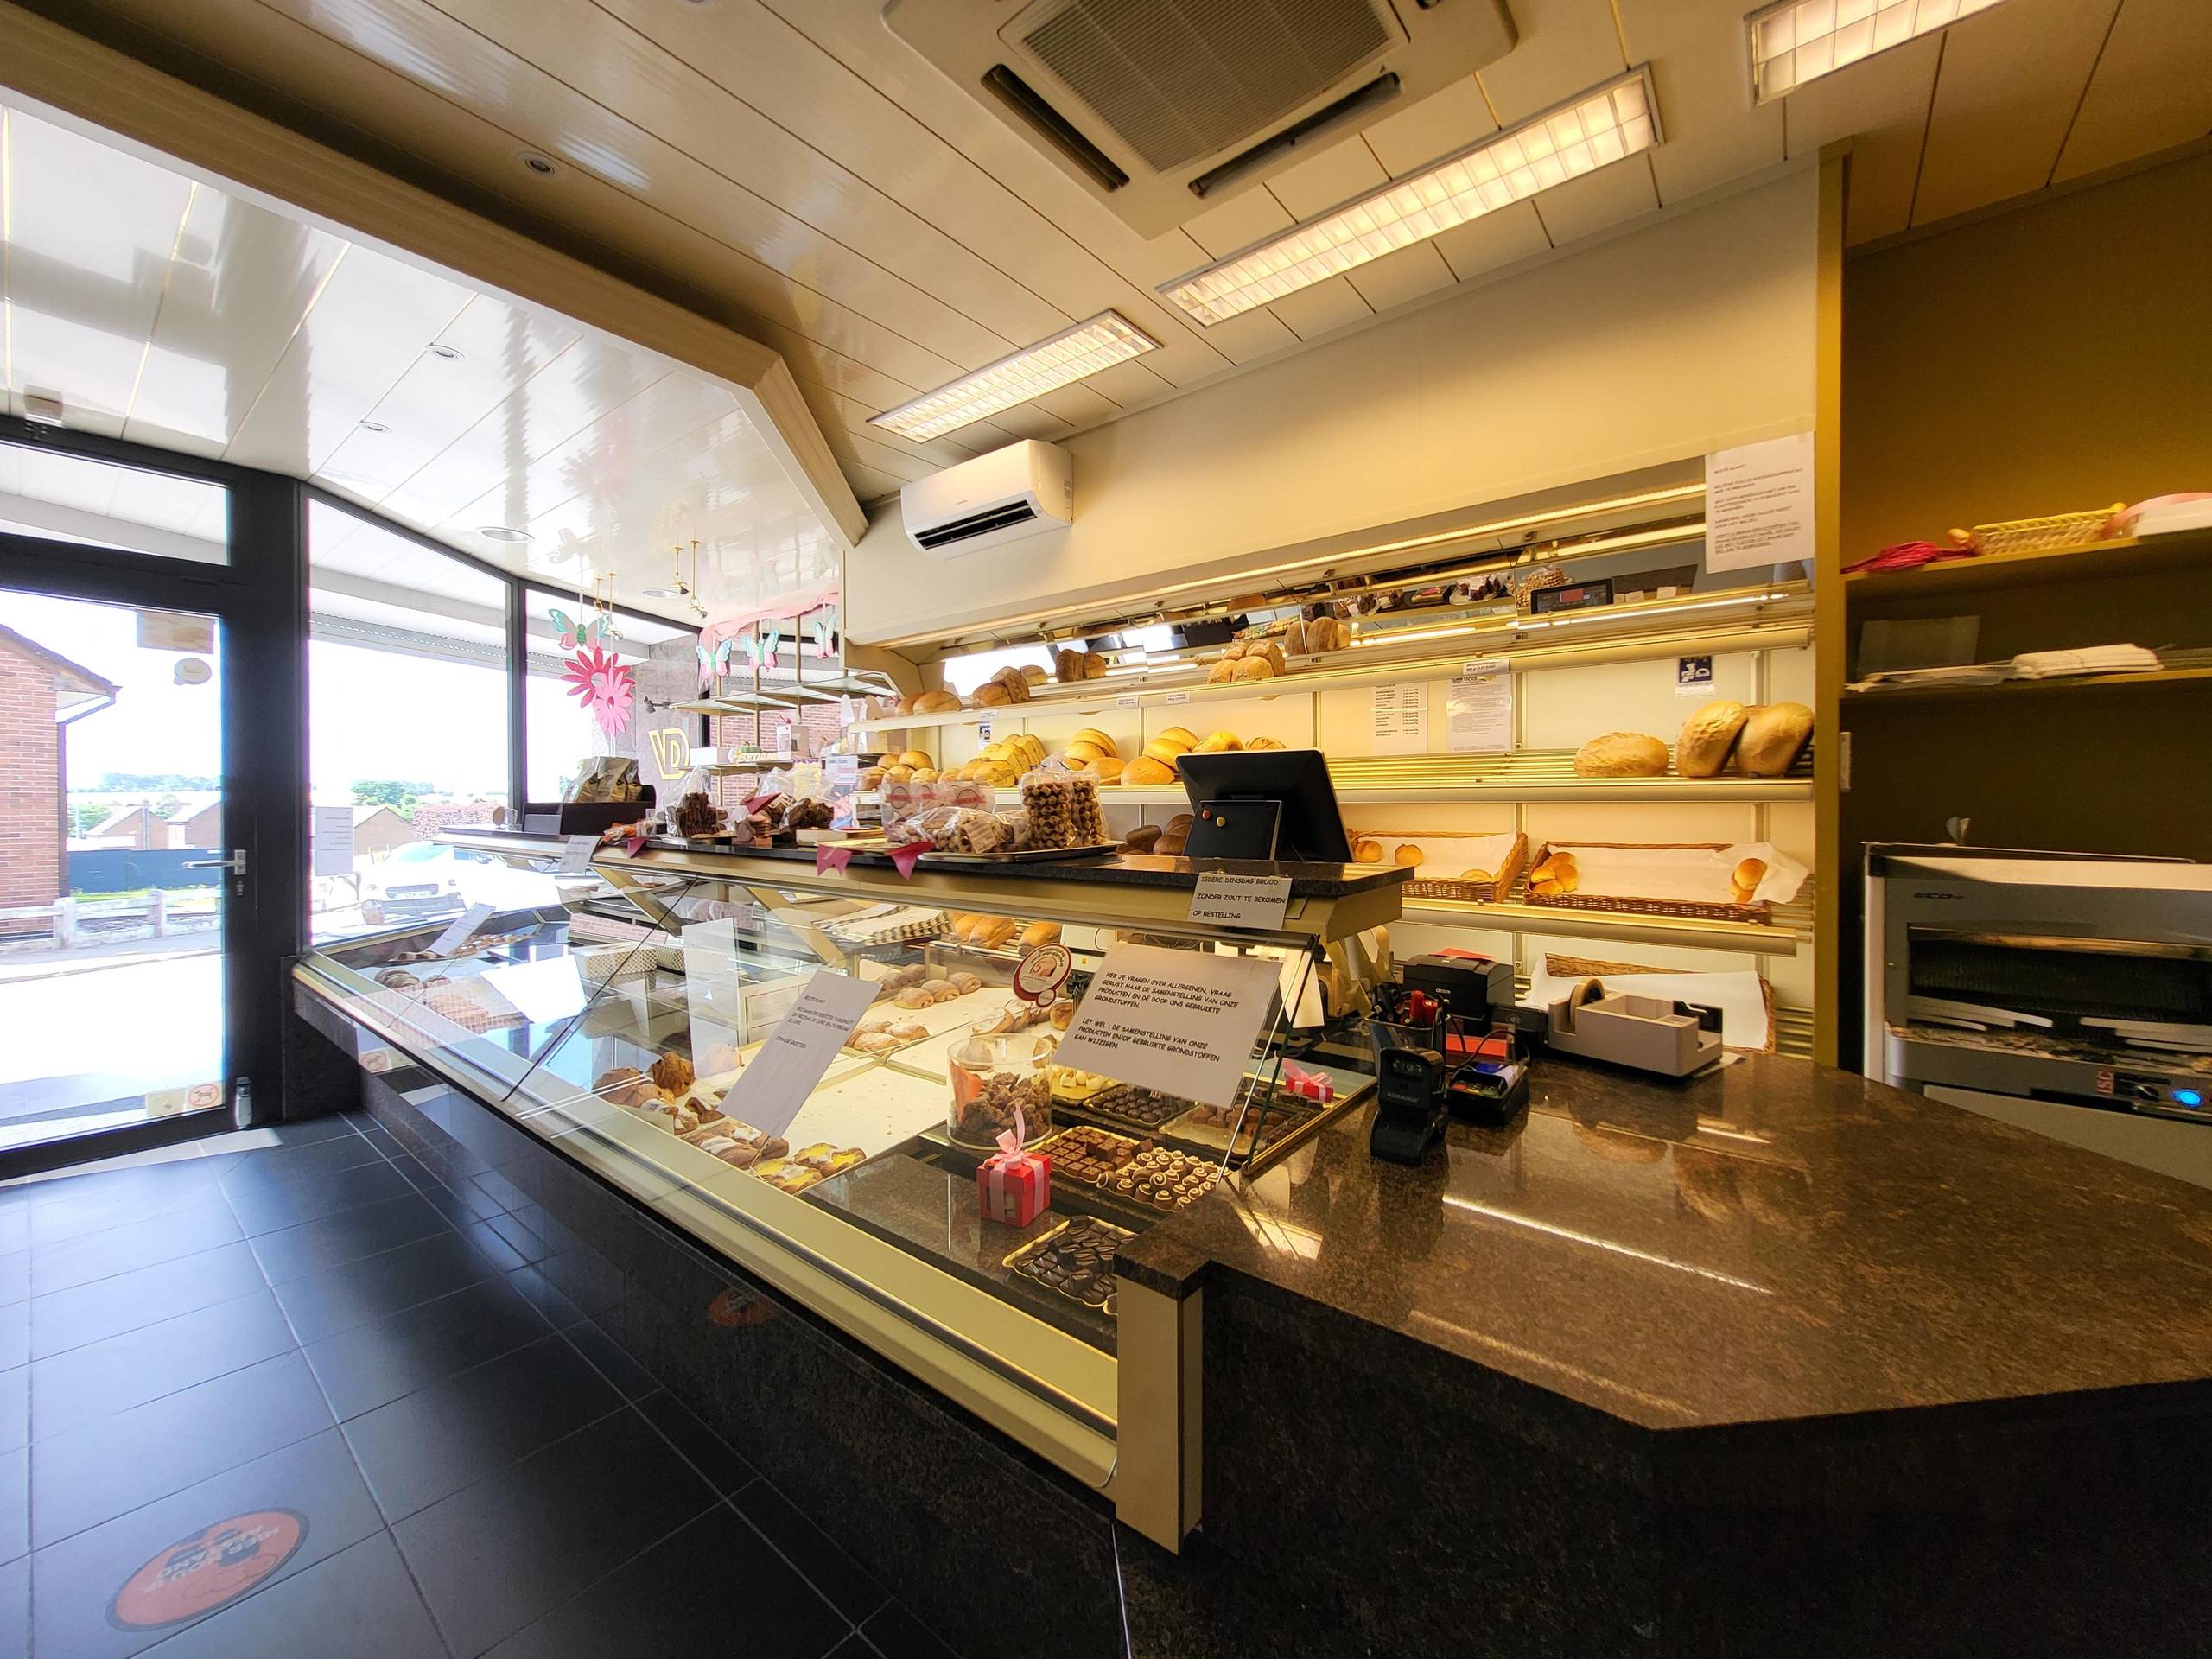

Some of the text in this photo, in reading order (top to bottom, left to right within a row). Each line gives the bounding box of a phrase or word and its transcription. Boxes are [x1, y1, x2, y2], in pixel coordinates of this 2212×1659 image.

[1203, 911, 1242, 919] BESTELLING
[1102, 979, 1124, 988] GERUST
[1151, 988, 1202, 1001] SAMENSTELLING
[1219, 999, 1239, 1008] ONZE
[1128, 976, 1150, 984] VRAGEN
[1211, 988, 1232, 998] VRAAG
[1098, 987, 1132, 998] PRODUCTEN
[1169, 999, 1183, 1007] ONS
[1184, 1001, 1221, 1014] GEBRUIKTE
[1074, 1033, 1087, 1042] KAN
[1078, 1025, 1221, 1063] PRODUCTEN EN/OF GEBRUIKTE GRONDSTOFFEN
[1121, 1026, 1172, 1041] SAMENSTELLING
[1173, 1036, 1188, 1045] VAN
[1188, 1039, 1209, 1050] ONZE
